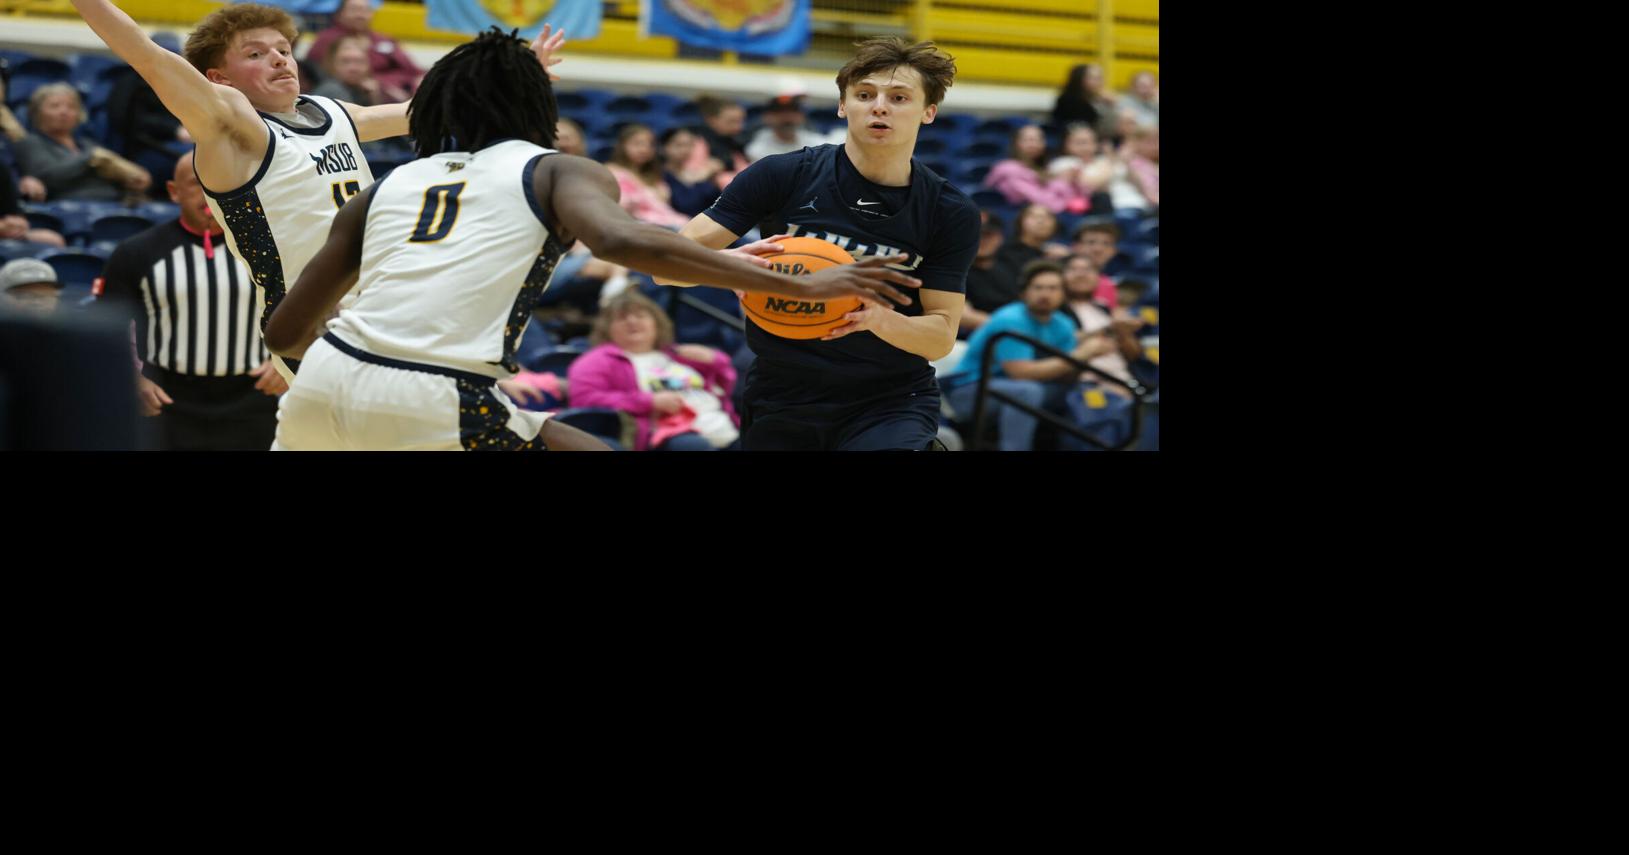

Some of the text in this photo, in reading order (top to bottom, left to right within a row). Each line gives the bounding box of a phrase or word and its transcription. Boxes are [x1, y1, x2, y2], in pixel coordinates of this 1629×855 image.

[309, 142, 358, 175] MSUB
[407, 180, 467, 243] 0
[764, 296, 826, 314] NCAA
